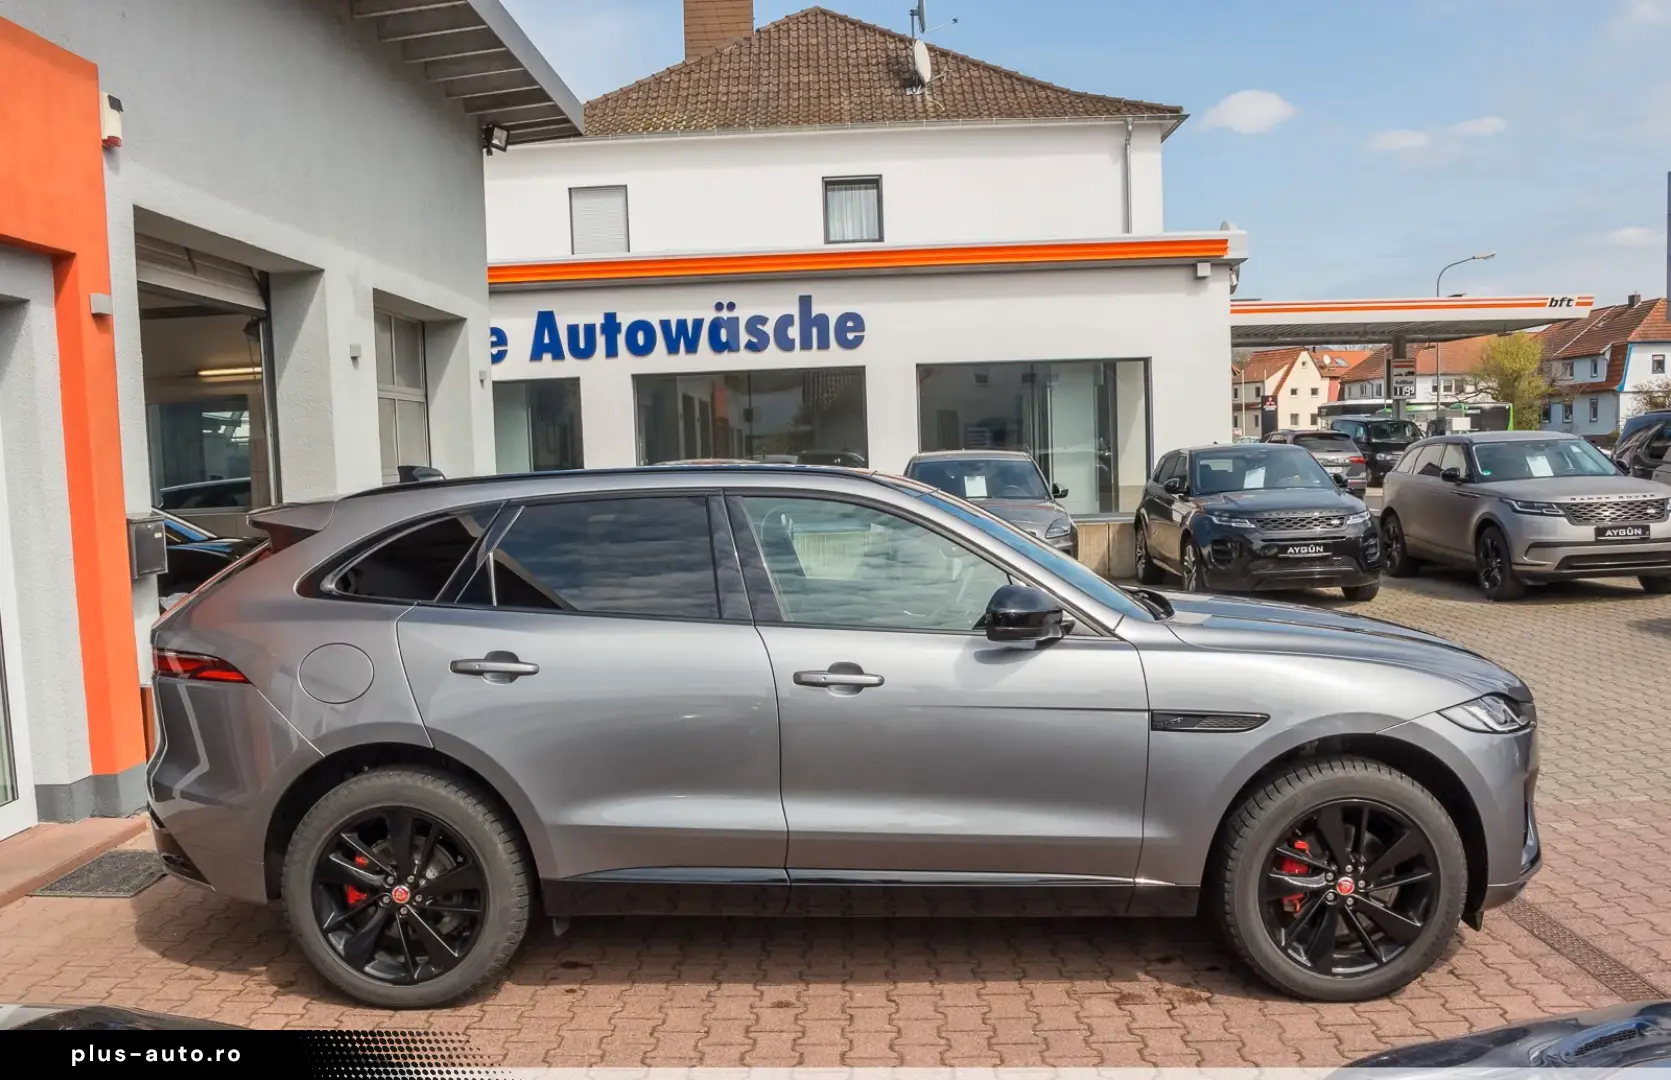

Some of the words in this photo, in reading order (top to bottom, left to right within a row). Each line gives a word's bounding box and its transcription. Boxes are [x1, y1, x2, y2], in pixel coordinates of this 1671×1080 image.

[1548, 297, 1575, 307] bft
[529, 295, 866, 362] Autowäsche
[1605, 526, 1642, 536] AYGÜN
[1287, 545, 1324, 554] AYGÜN
